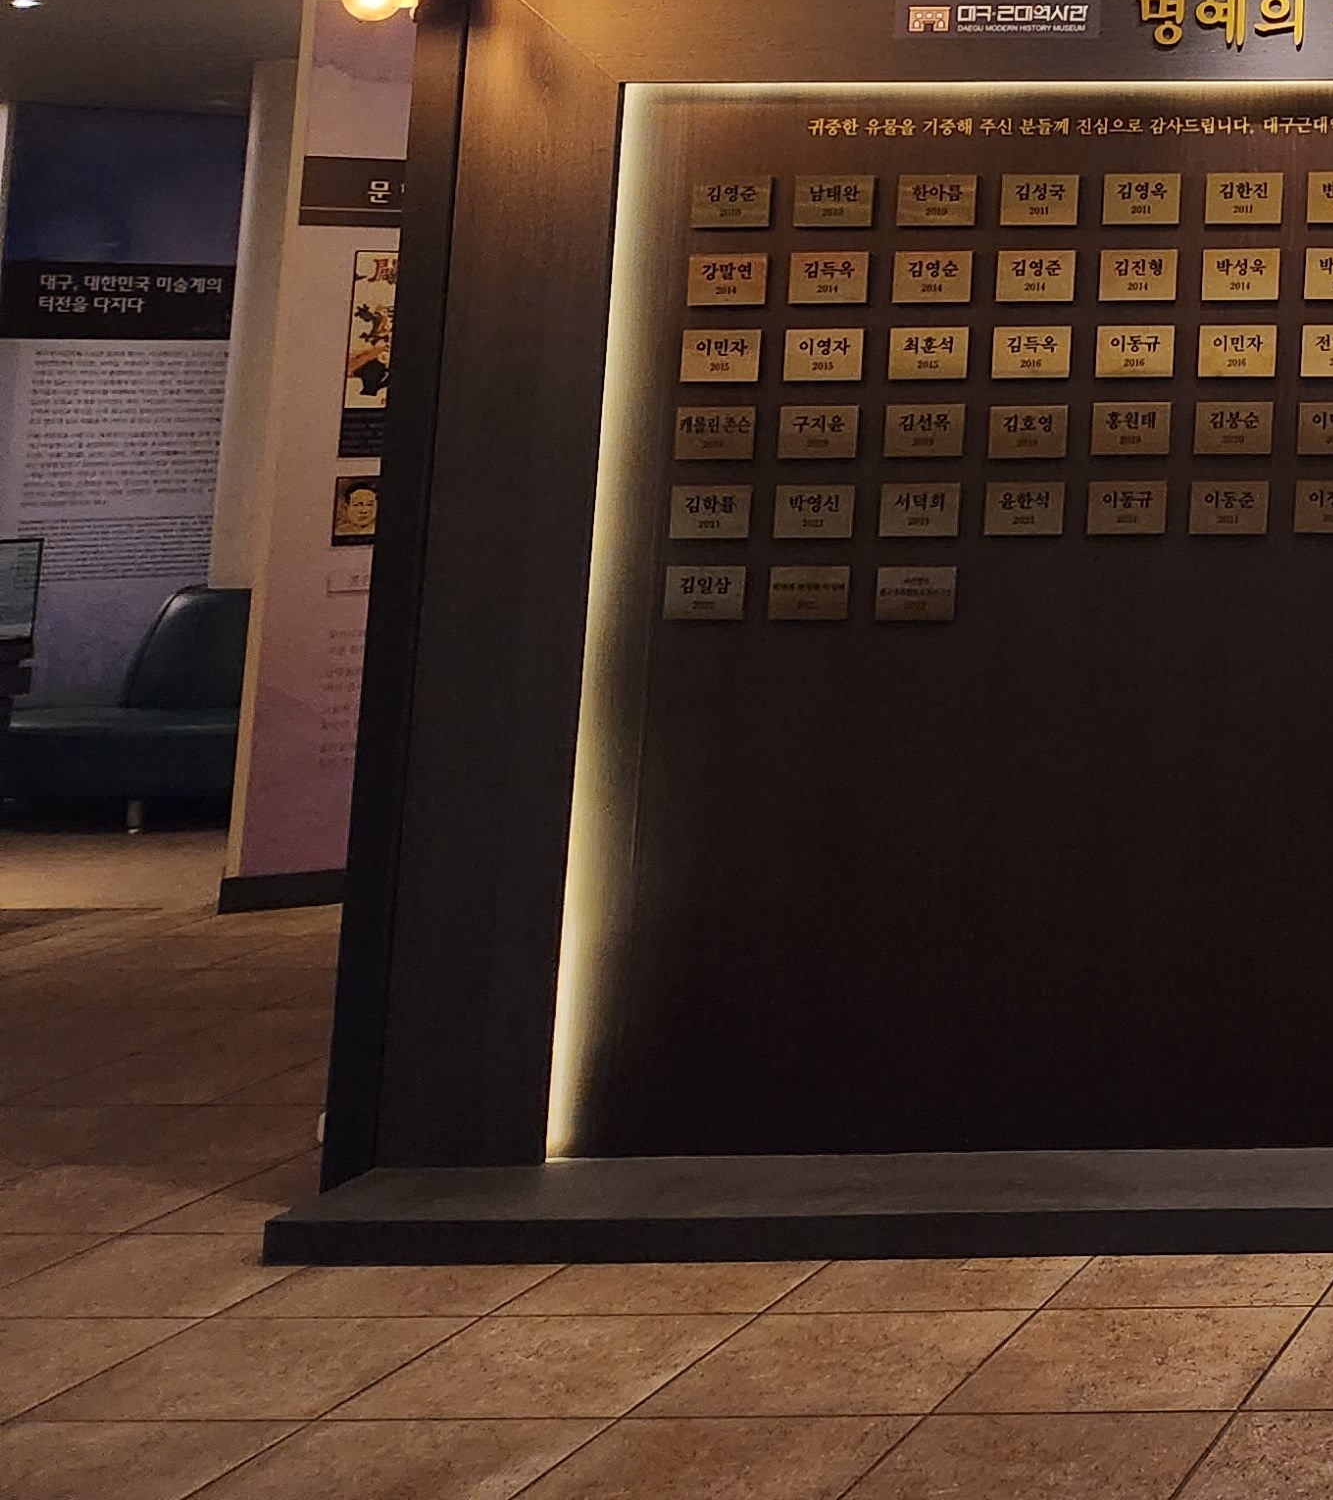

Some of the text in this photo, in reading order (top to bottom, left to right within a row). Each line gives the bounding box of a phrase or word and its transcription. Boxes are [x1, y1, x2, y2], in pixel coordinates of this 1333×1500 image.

[808, 117, 859, 136] 귀중한
[865, 117, 914, 137] 유물을
[923, 117, 972, 136] 기증해
[980, 117, 1013, 136] 주신
[1019, 117, 1069, 135] 분들께
[1077, 117, 1143, 135] 진심으로
[1149, 116, 1255, 136] 감사드립니다.
[707, 184, 758, 202] 김영준
[810, 184, 860, 202] 남태완
[1016, 182, 1066, 200] 김성국
[1117, 181, 1168, 200] 김영옥
[1220, 181, 1268, 200] 김한진
[702, 262, 752, 280] 강말연
[908, 260, 959, 278] 김영순
[1012, 258, 1062, 277] 김영준
[1216, 258, 1266, 276] 박성욱
[40, 275, 223, 293] 대구, 대한민국 미술계의
[38, 296, 145, 314] 터전을 다지다
[696, 338, 748, 356] 이민자
[799, 337, 850, 356] 이영자
[904, 336, 954, 354] 최훈석
[1006, 335, 1058, 353] 김득옥
[1110, 335, 1160, 353] 이동규
[1213, 334, 1263, 352] 이민자
[793, 415, 845, 434] 구지윤
[1003, 413, 1054, 434] 김호영
[1106, 411, 1156, 430] 홍원태
[789, 494, 840, 513] 박영신
[1102, 491, 1154, 509] 이동규
[680, 575, 732, 597] 김일삼
